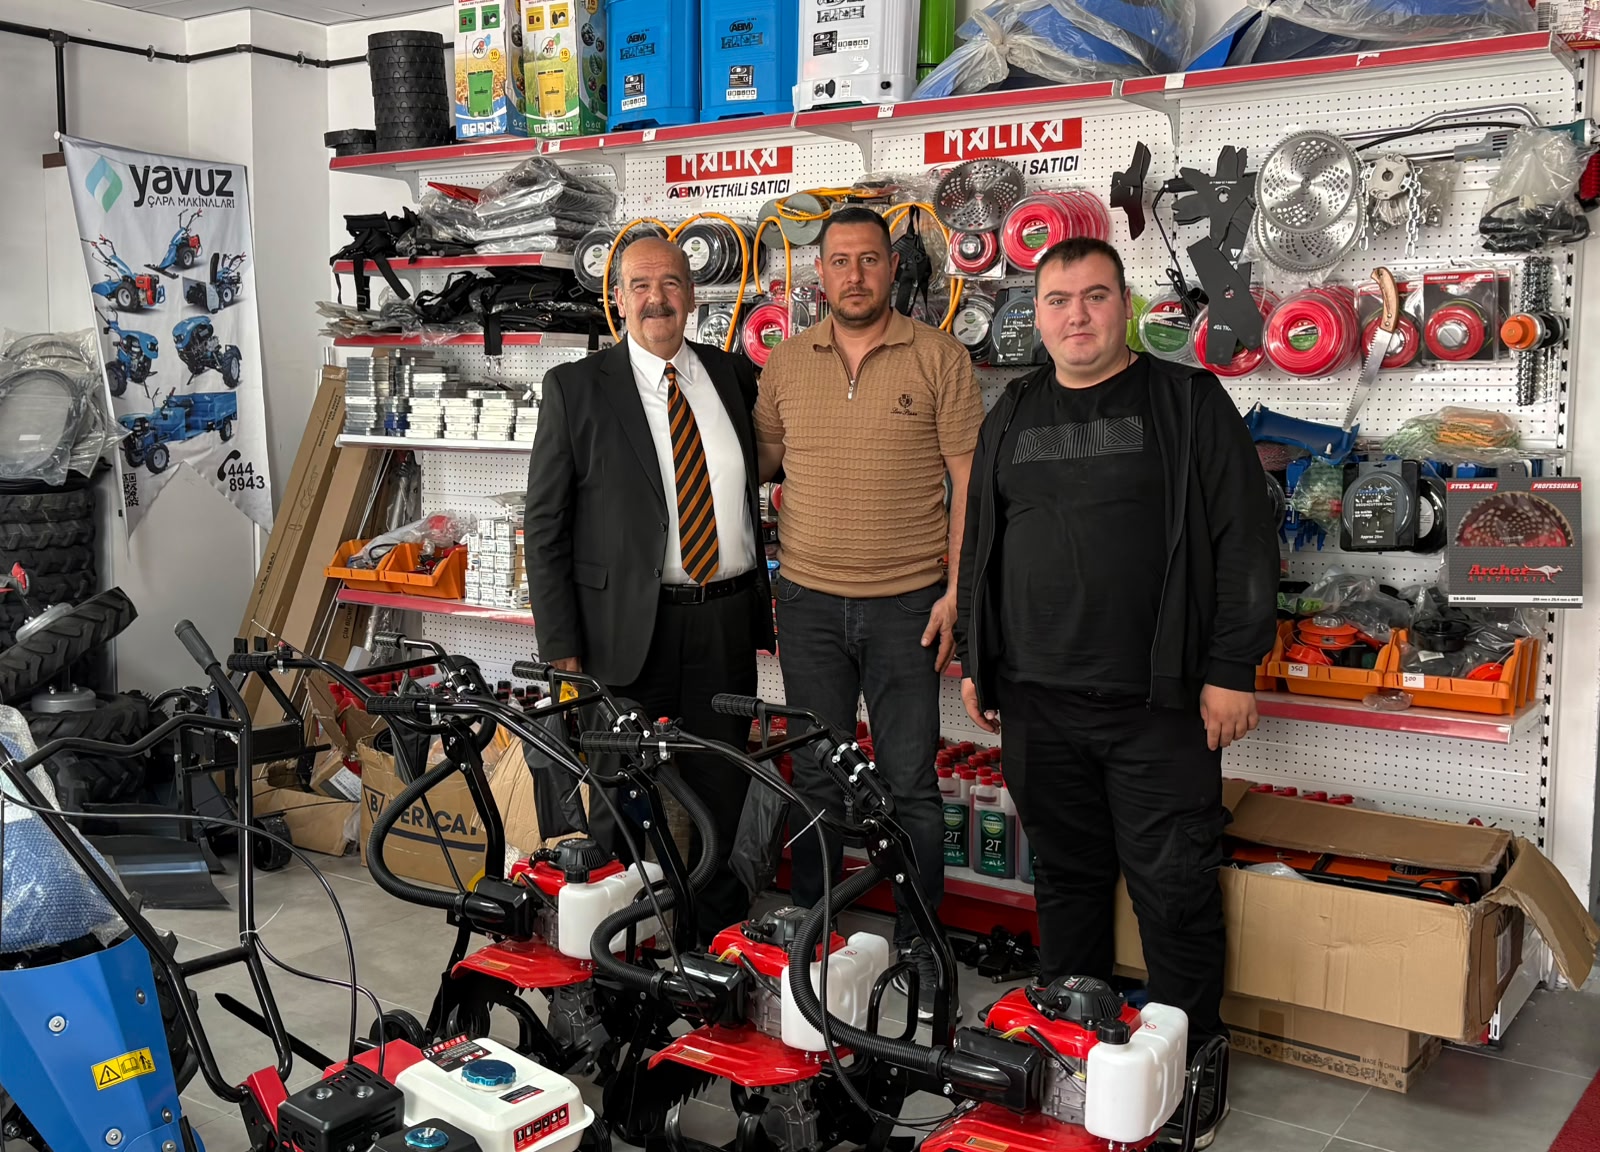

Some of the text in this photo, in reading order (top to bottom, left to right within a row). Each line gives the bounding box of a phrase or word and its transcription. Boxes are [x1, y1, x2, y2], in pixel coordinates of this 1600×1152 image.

[1030, 155, 1080, 175] SATICI
[128, 164, 234, 208] yavuz
[668, 185, 701, 200] ABM
[750, 179, 790, 195] SATICI
[147, 196, 175, 208] ÇAPA
[228, 462, 254, 477] 444
[229, 476, 265, 491] 8943
[1468, 564, 1529, 576] Archer
[944, 831, 961, 843] 2T
[985, 839, 1001, 852] 2T
